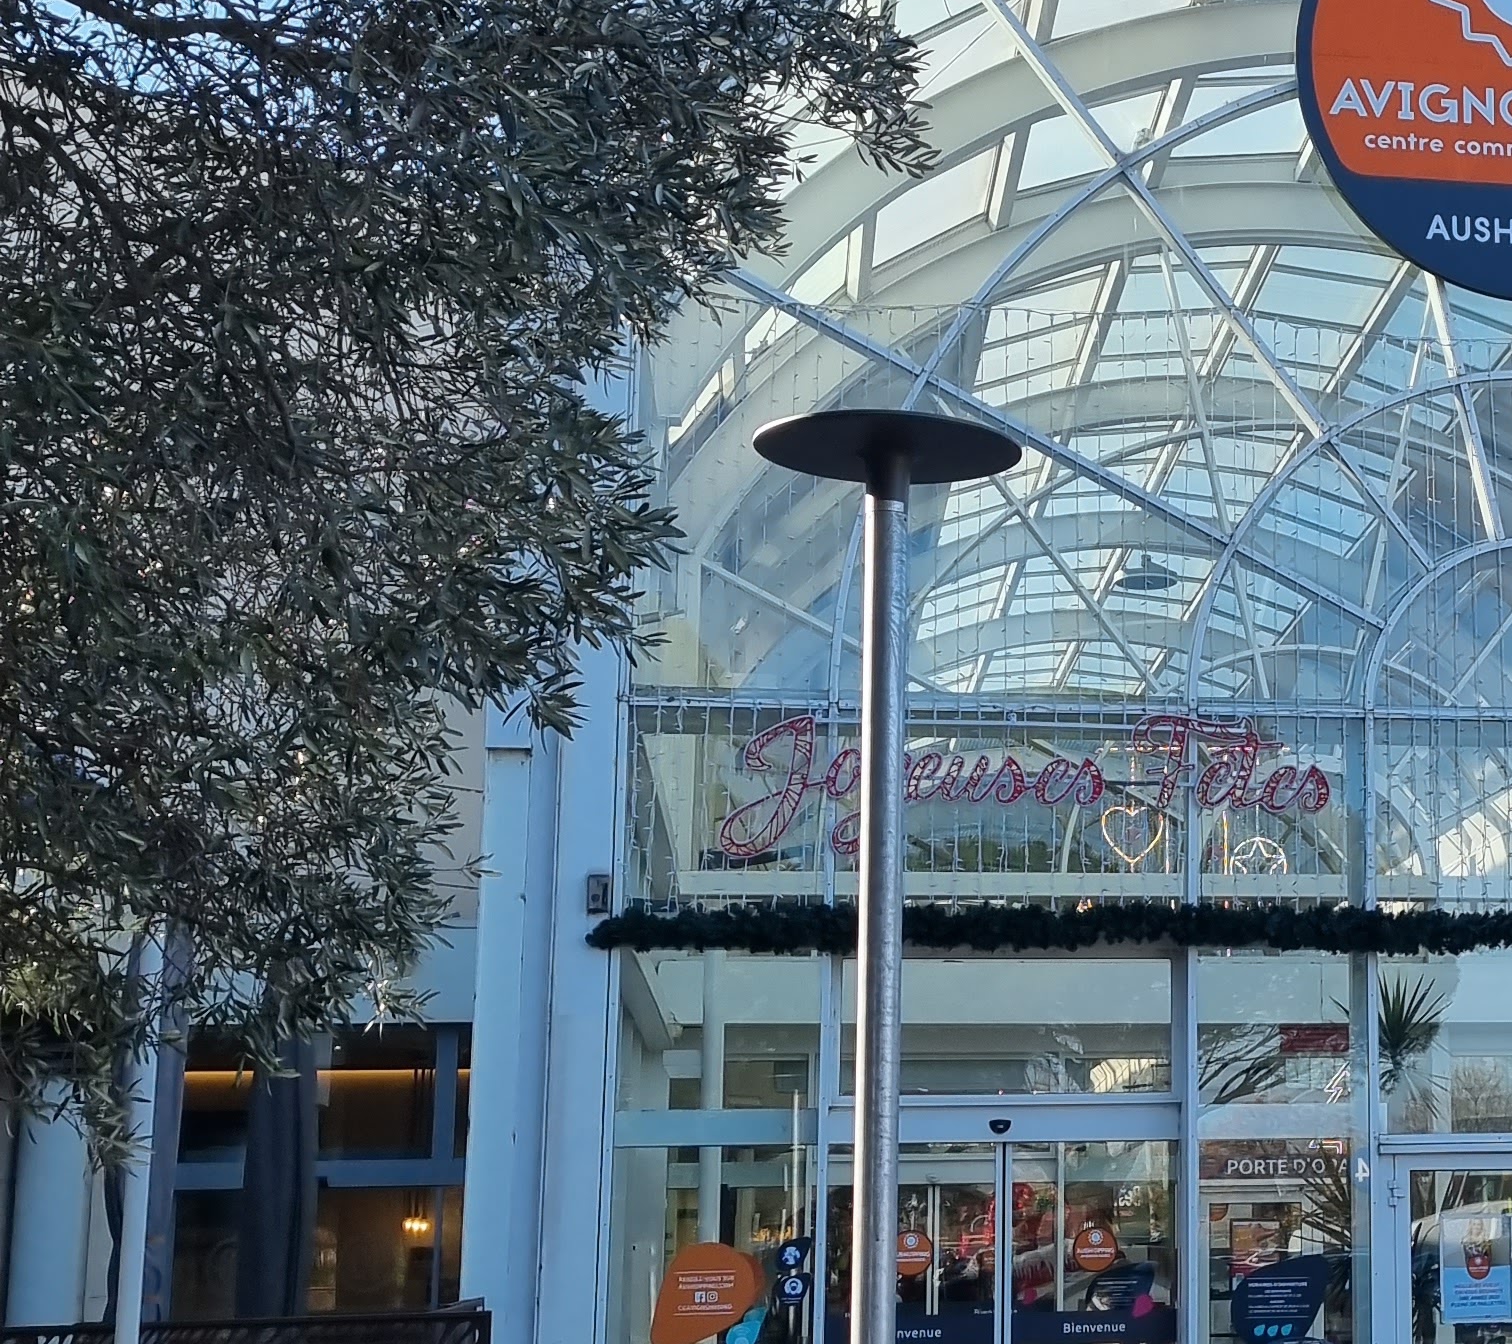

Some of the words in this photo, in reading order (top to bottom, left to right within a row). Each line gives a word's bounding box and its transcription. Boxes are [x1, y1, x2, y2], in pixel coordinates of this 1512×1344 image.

[1363, 132, 1444, 153] centre
[1226, 1158, 1289, 1175] PORTE
[896, 1328, 943, 1339] nvenue
[1063, 1321, 1127, 1334] Bienvenue
